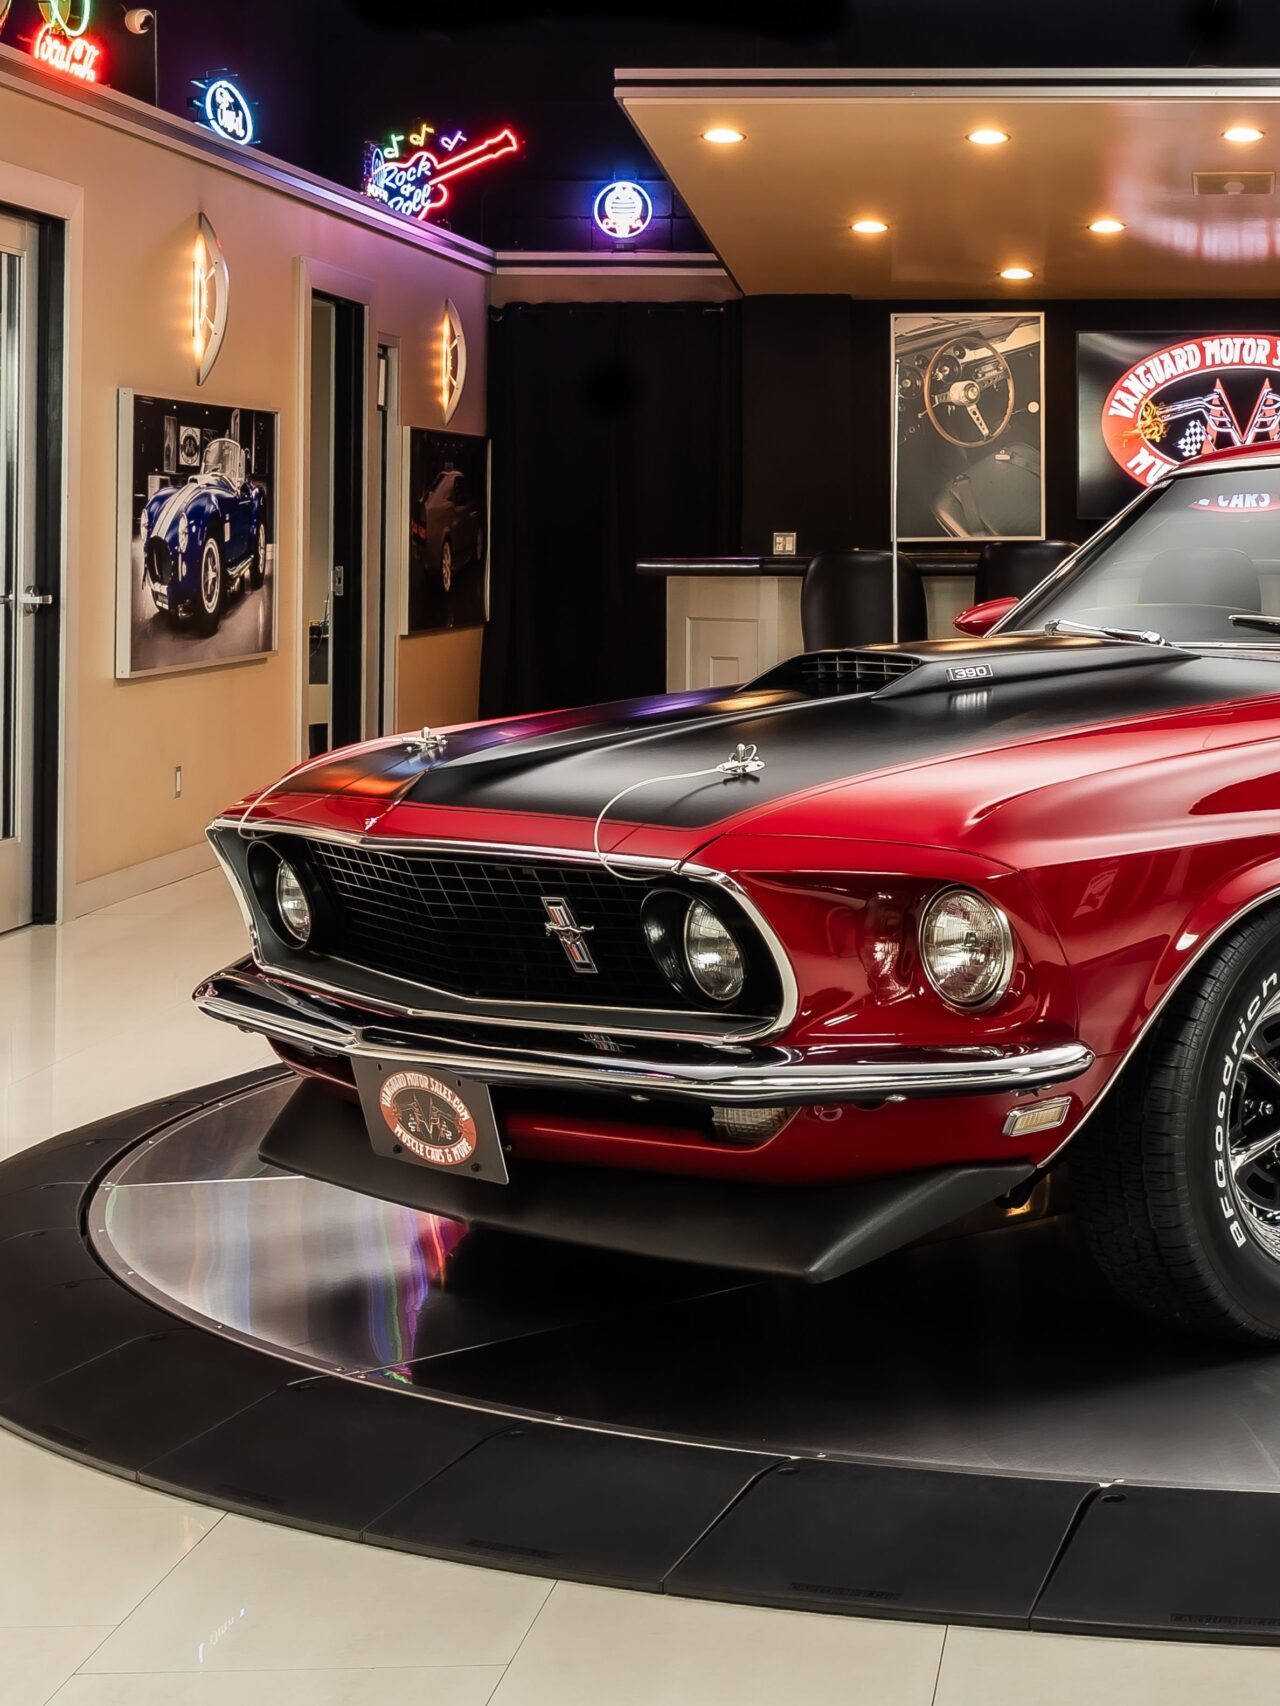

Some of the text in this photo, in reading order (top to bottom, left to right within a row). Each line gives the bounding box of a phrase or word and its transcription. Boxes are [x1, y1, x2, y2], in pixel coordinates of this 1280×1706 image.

[378, 155, 432, 189] Rock
[1108, 344, 1202, 419] VANGUARD
[1204, 337, 1272, 366] MOTOR
[954, 666, 988, 678] 390
[382, 1072, 471, 1121] VANGUARD MOTOR SALES.COM
[1214, 971, 1278, 1248] BFGoodrich
[394, 1124, 425, 1156] MUSCLE
[425, 1146, 446, 1163] CARS
[451, 1137, 473, 1161] MORE
